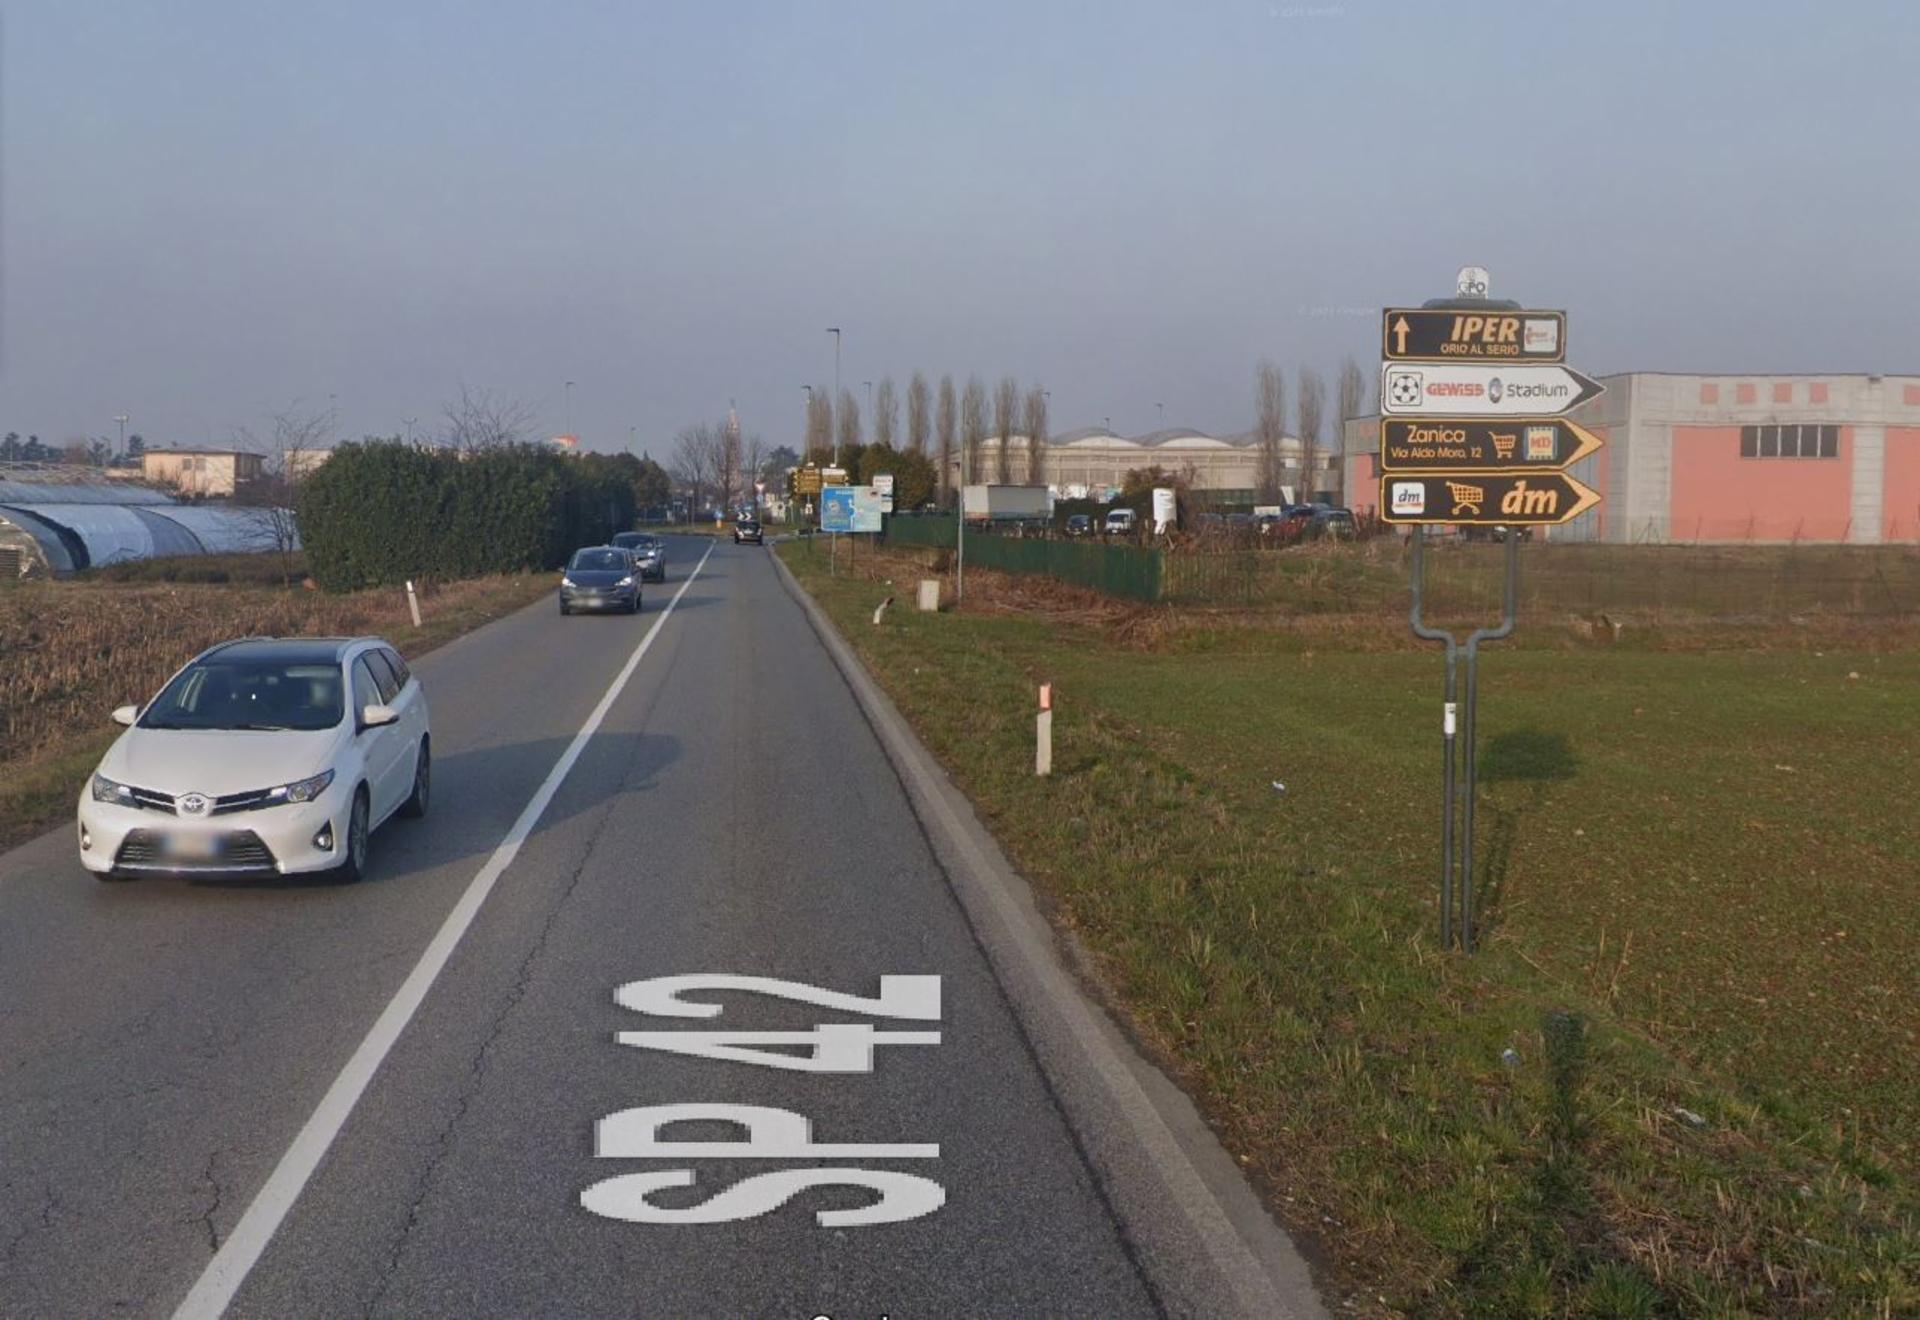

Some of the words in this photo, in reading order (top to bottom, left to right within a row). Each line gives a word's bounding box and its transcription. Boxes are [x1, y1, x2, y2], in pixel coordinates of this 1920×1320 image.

[1451, 316, 1521, 342] IPER
[1440, 343, 1468, 354] ORIO
[1470, 344, 1484, 354] AL
[1486, 344, 1520, 355] SERIO
[1507, 383, 1568, 397] Stadium
[1407, 424, 1466, 443] Zanica
[1391, 447, 1408, 458] Via
[1411, 447, 1435, 458] Aldo
[1471, 447, 1482, 458] 12
[1398, 489, 1420, 502] dm
[1501, 481, 1558, 514] dm
